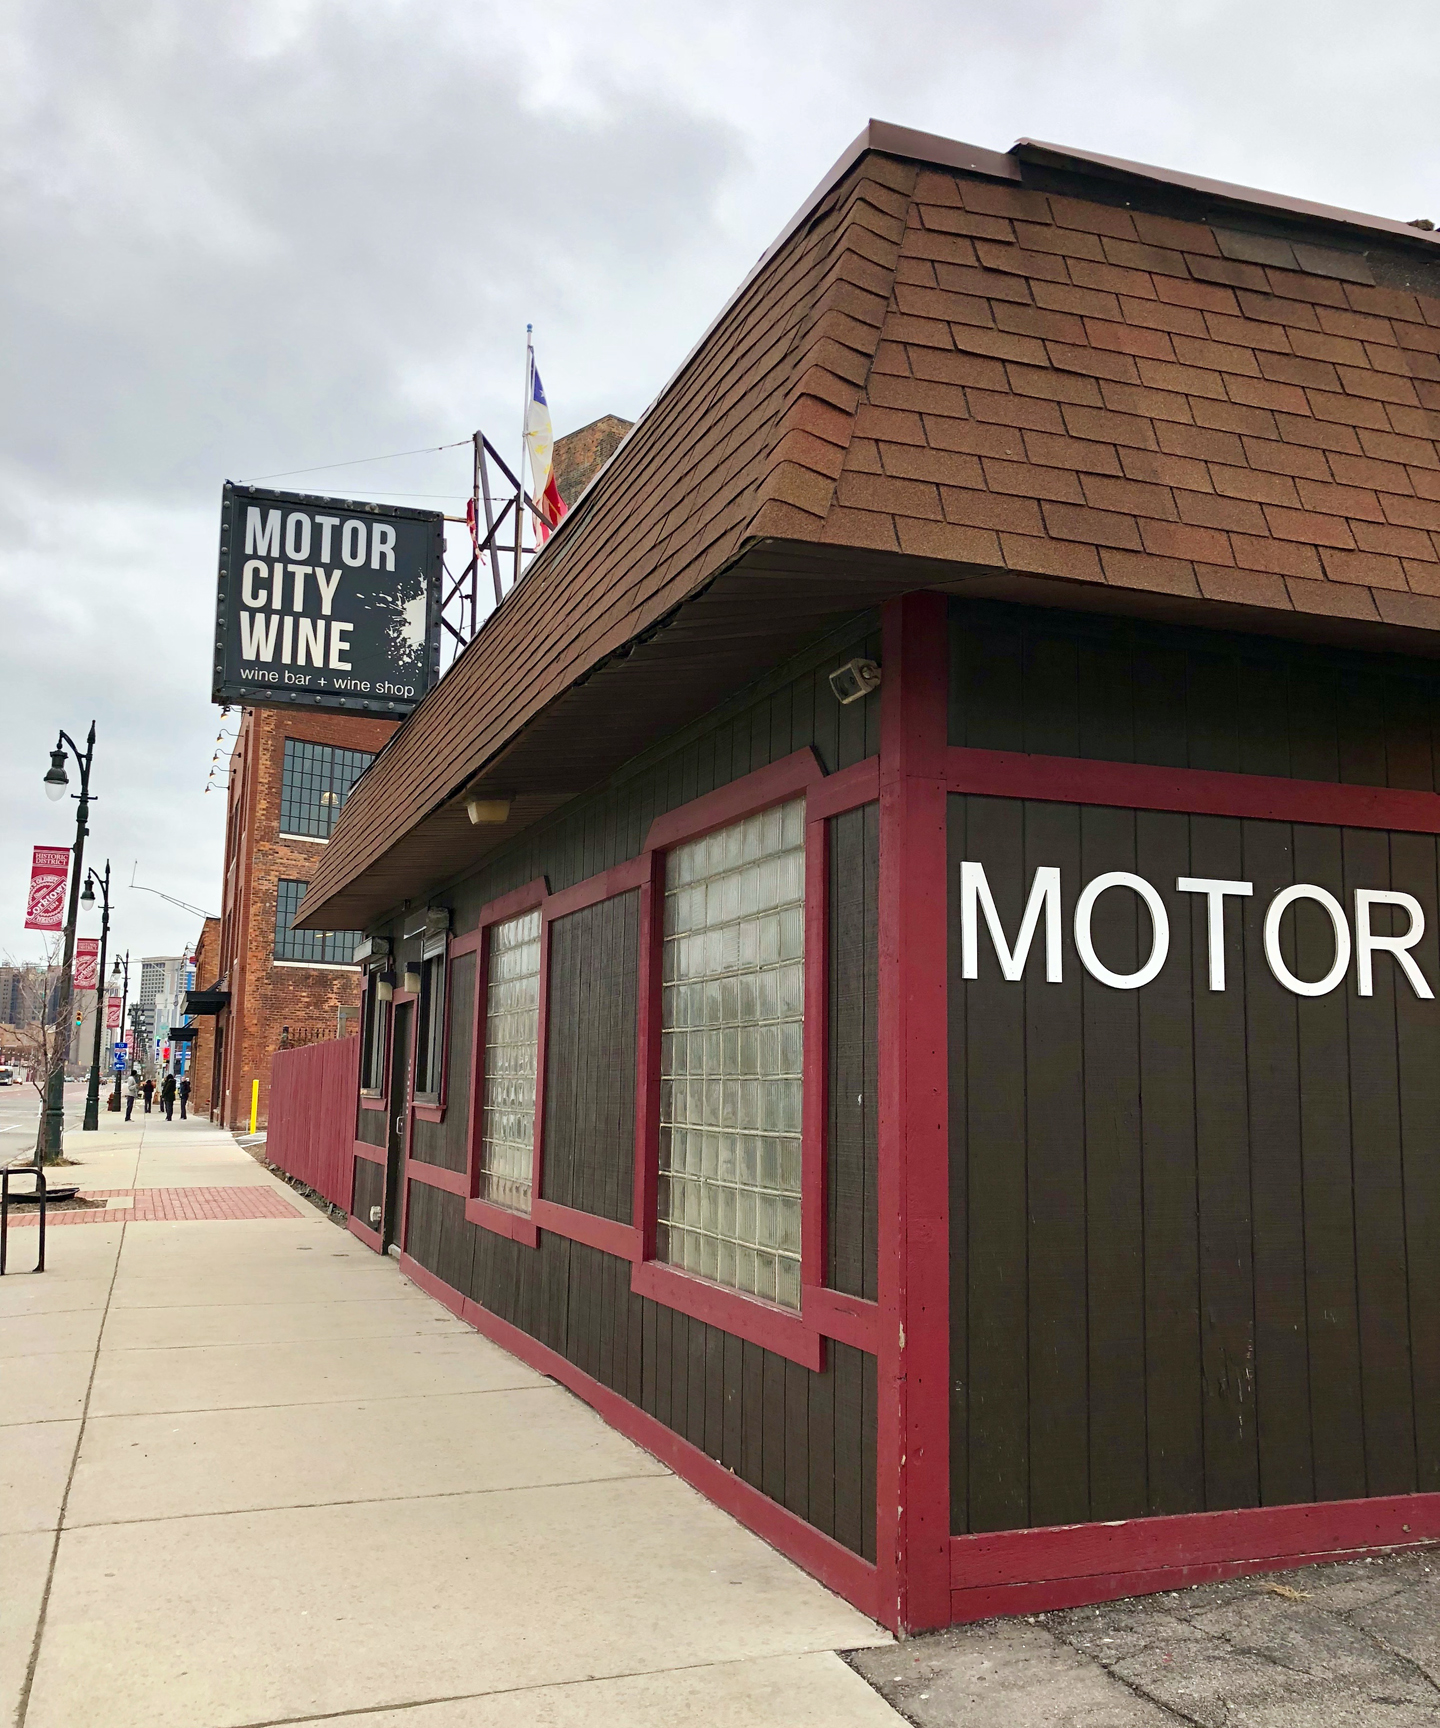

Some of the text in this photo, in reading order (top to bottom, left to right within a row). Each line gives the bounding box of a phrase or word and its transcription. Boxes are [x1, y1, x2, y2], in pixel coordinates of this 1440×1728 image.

[244, 506, 397, 572] MOTOR
[241, 559, 343, 616] CITY
[239, 610, 354, 671] WINE
[240, 666, 415, 698] wine bar + wine shop
[35, 858, 67, 866] DISTRICT
[36, 852, 69, 861] HISTORIC
[960, 860, 1436, 999] MOTOR
[115, 1051, 126, 1059] 75
